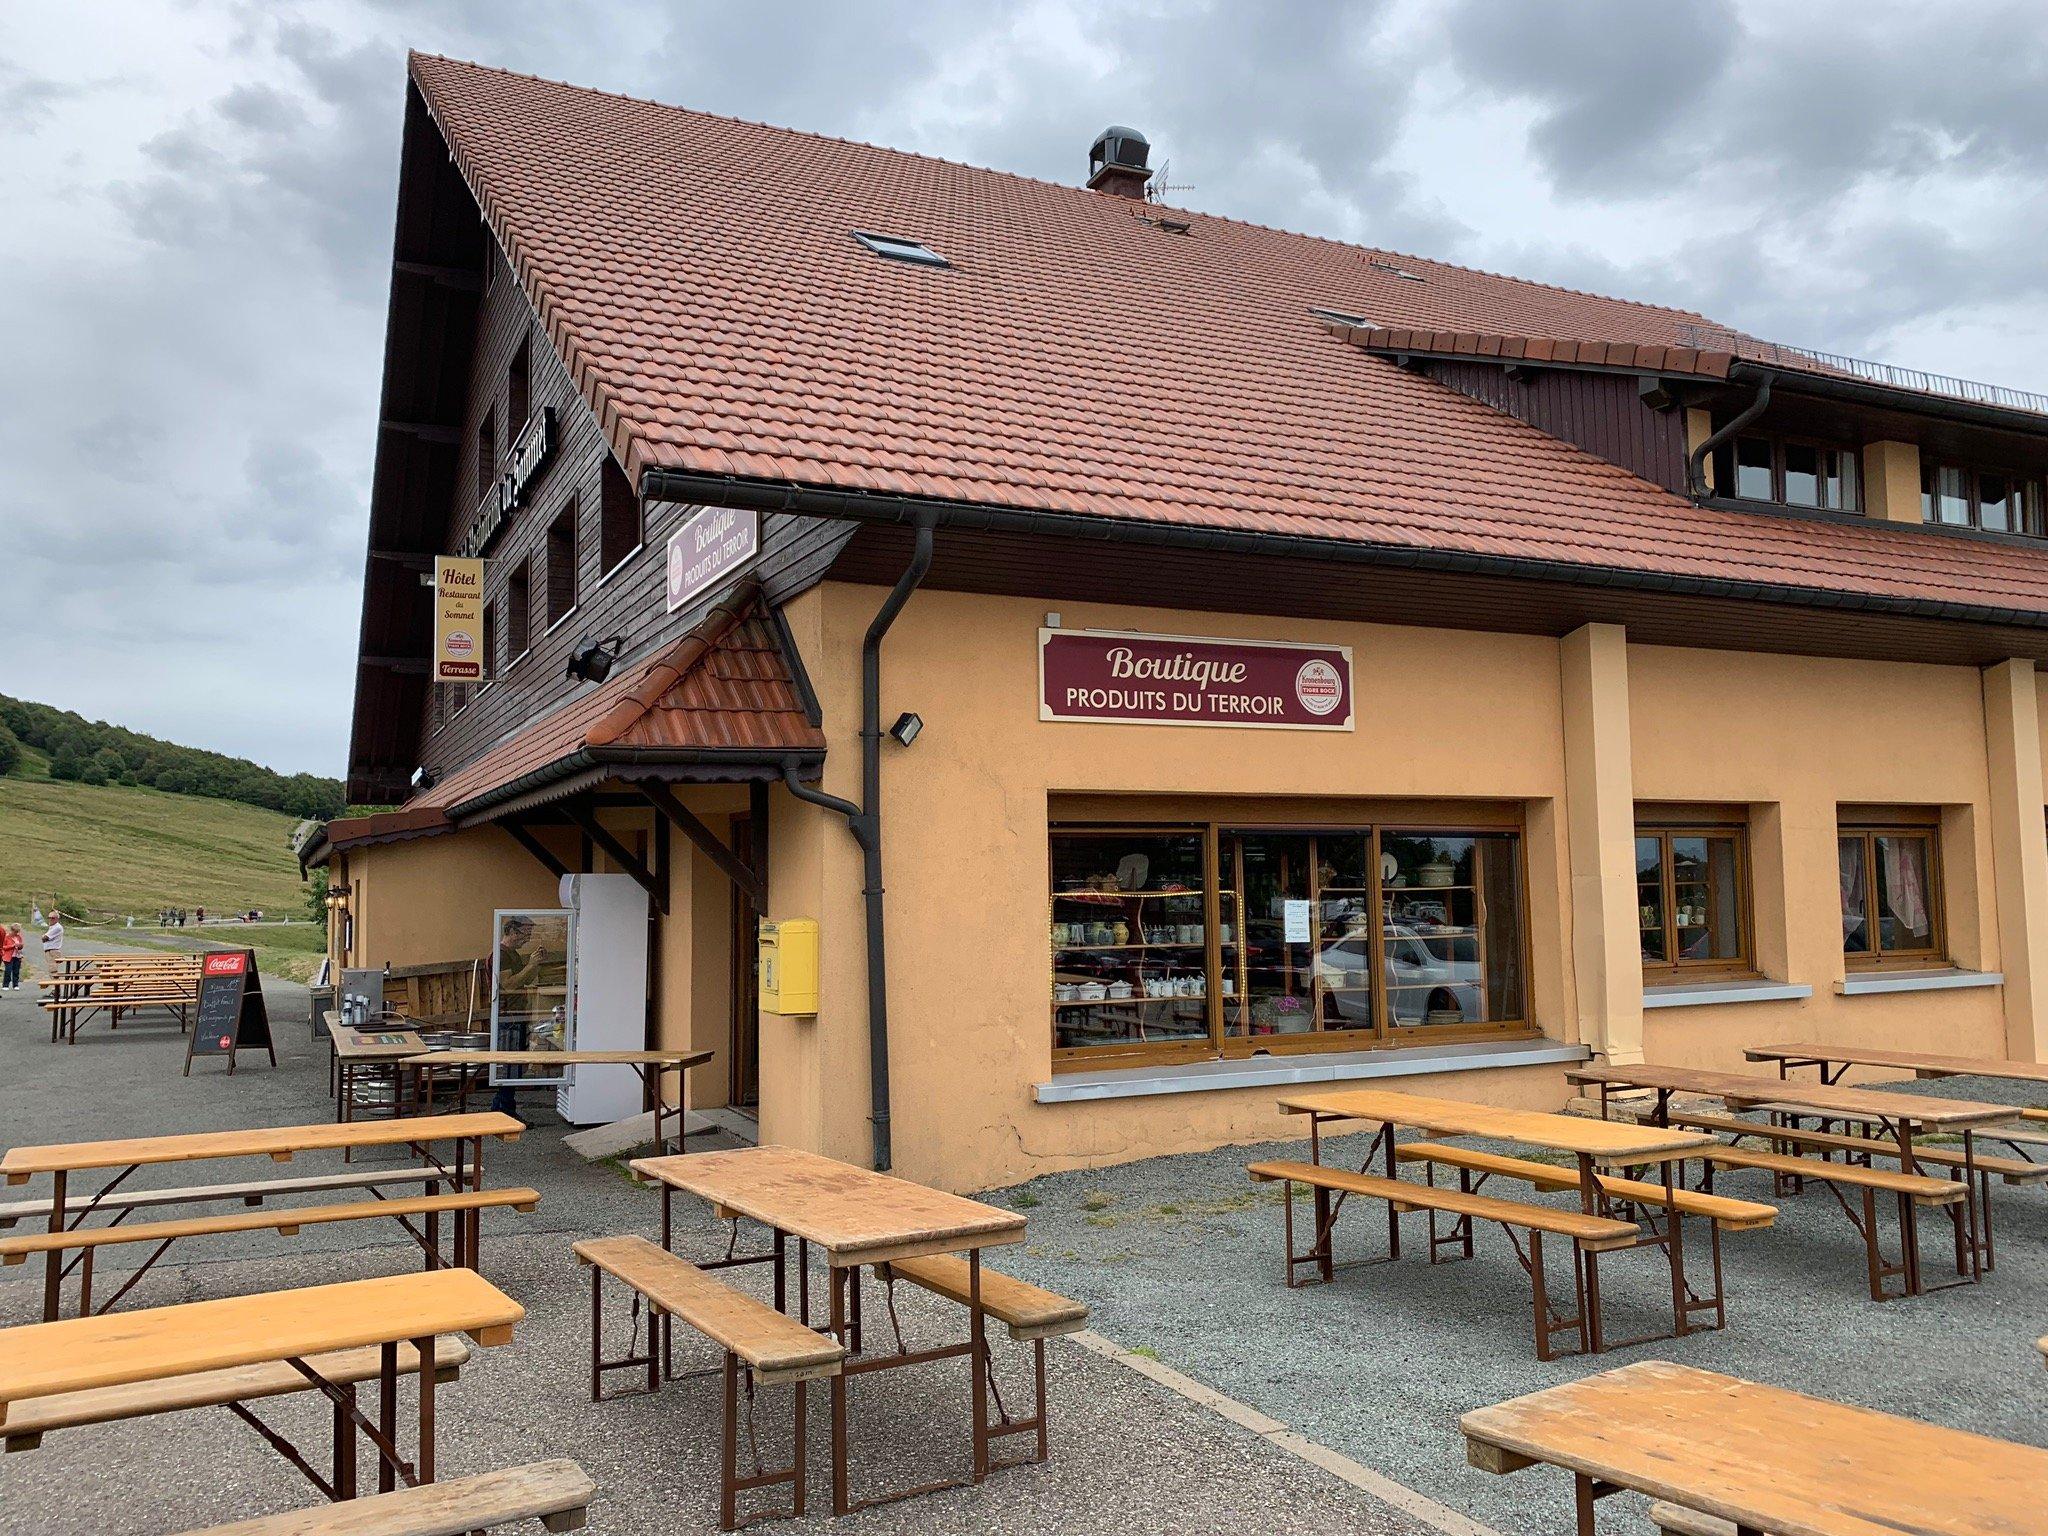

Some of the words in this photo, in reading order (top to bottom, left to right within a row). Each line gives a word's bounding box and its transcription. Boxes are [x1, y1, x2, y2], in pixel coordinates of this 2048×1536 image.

[695, 509, 737, 553] Boutique
[684, 554, 712, 589] PRODUITS
[712, 547, 722, 569] DU
[722, 527, 749, 561] TERROIR
[442, 568, 477, 586] Hôtel
[438, 587, 481, 600] Restaurant
[444, 610, 475, 620] Sommet
[441, 664, 477, 675] Terrasse
[1105, 647, 1248, 690] Boutique
[1066, 687, 1166, 712] PRODUITS
[1173, 692, 1202, 713] DU
[1207, 694, 1285, 715] TERROIR
